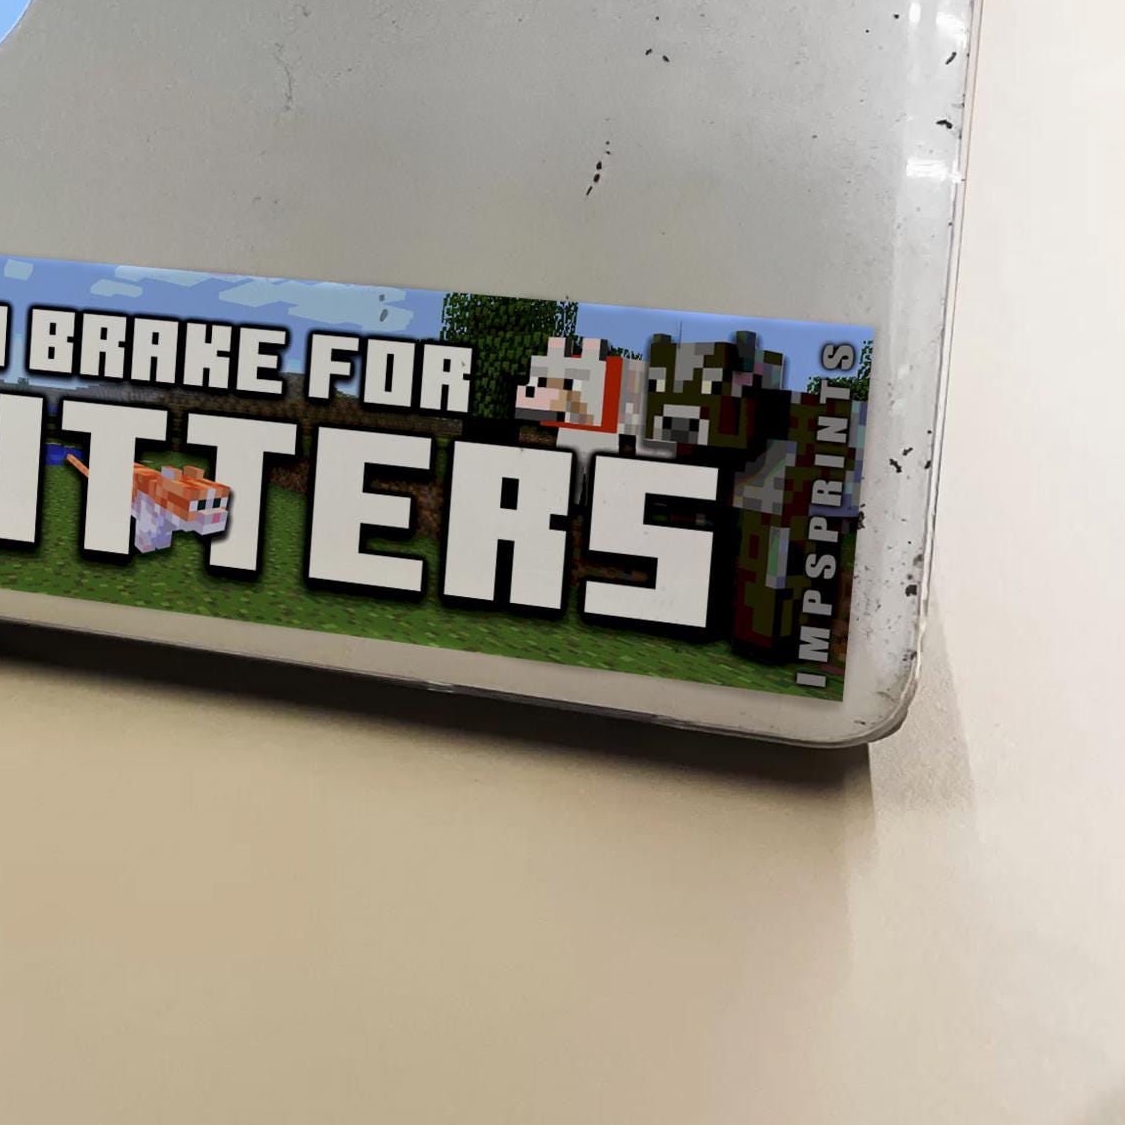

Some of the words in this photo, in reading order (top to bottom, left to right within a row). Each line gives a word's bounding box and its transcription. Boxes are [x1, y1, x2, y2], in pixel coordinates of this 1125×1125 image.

[29, 308, 286, 395] BRAKE
[310, 333, 473, 412] FOR
[796, 342, 855, 688] IMPSPRINTS
